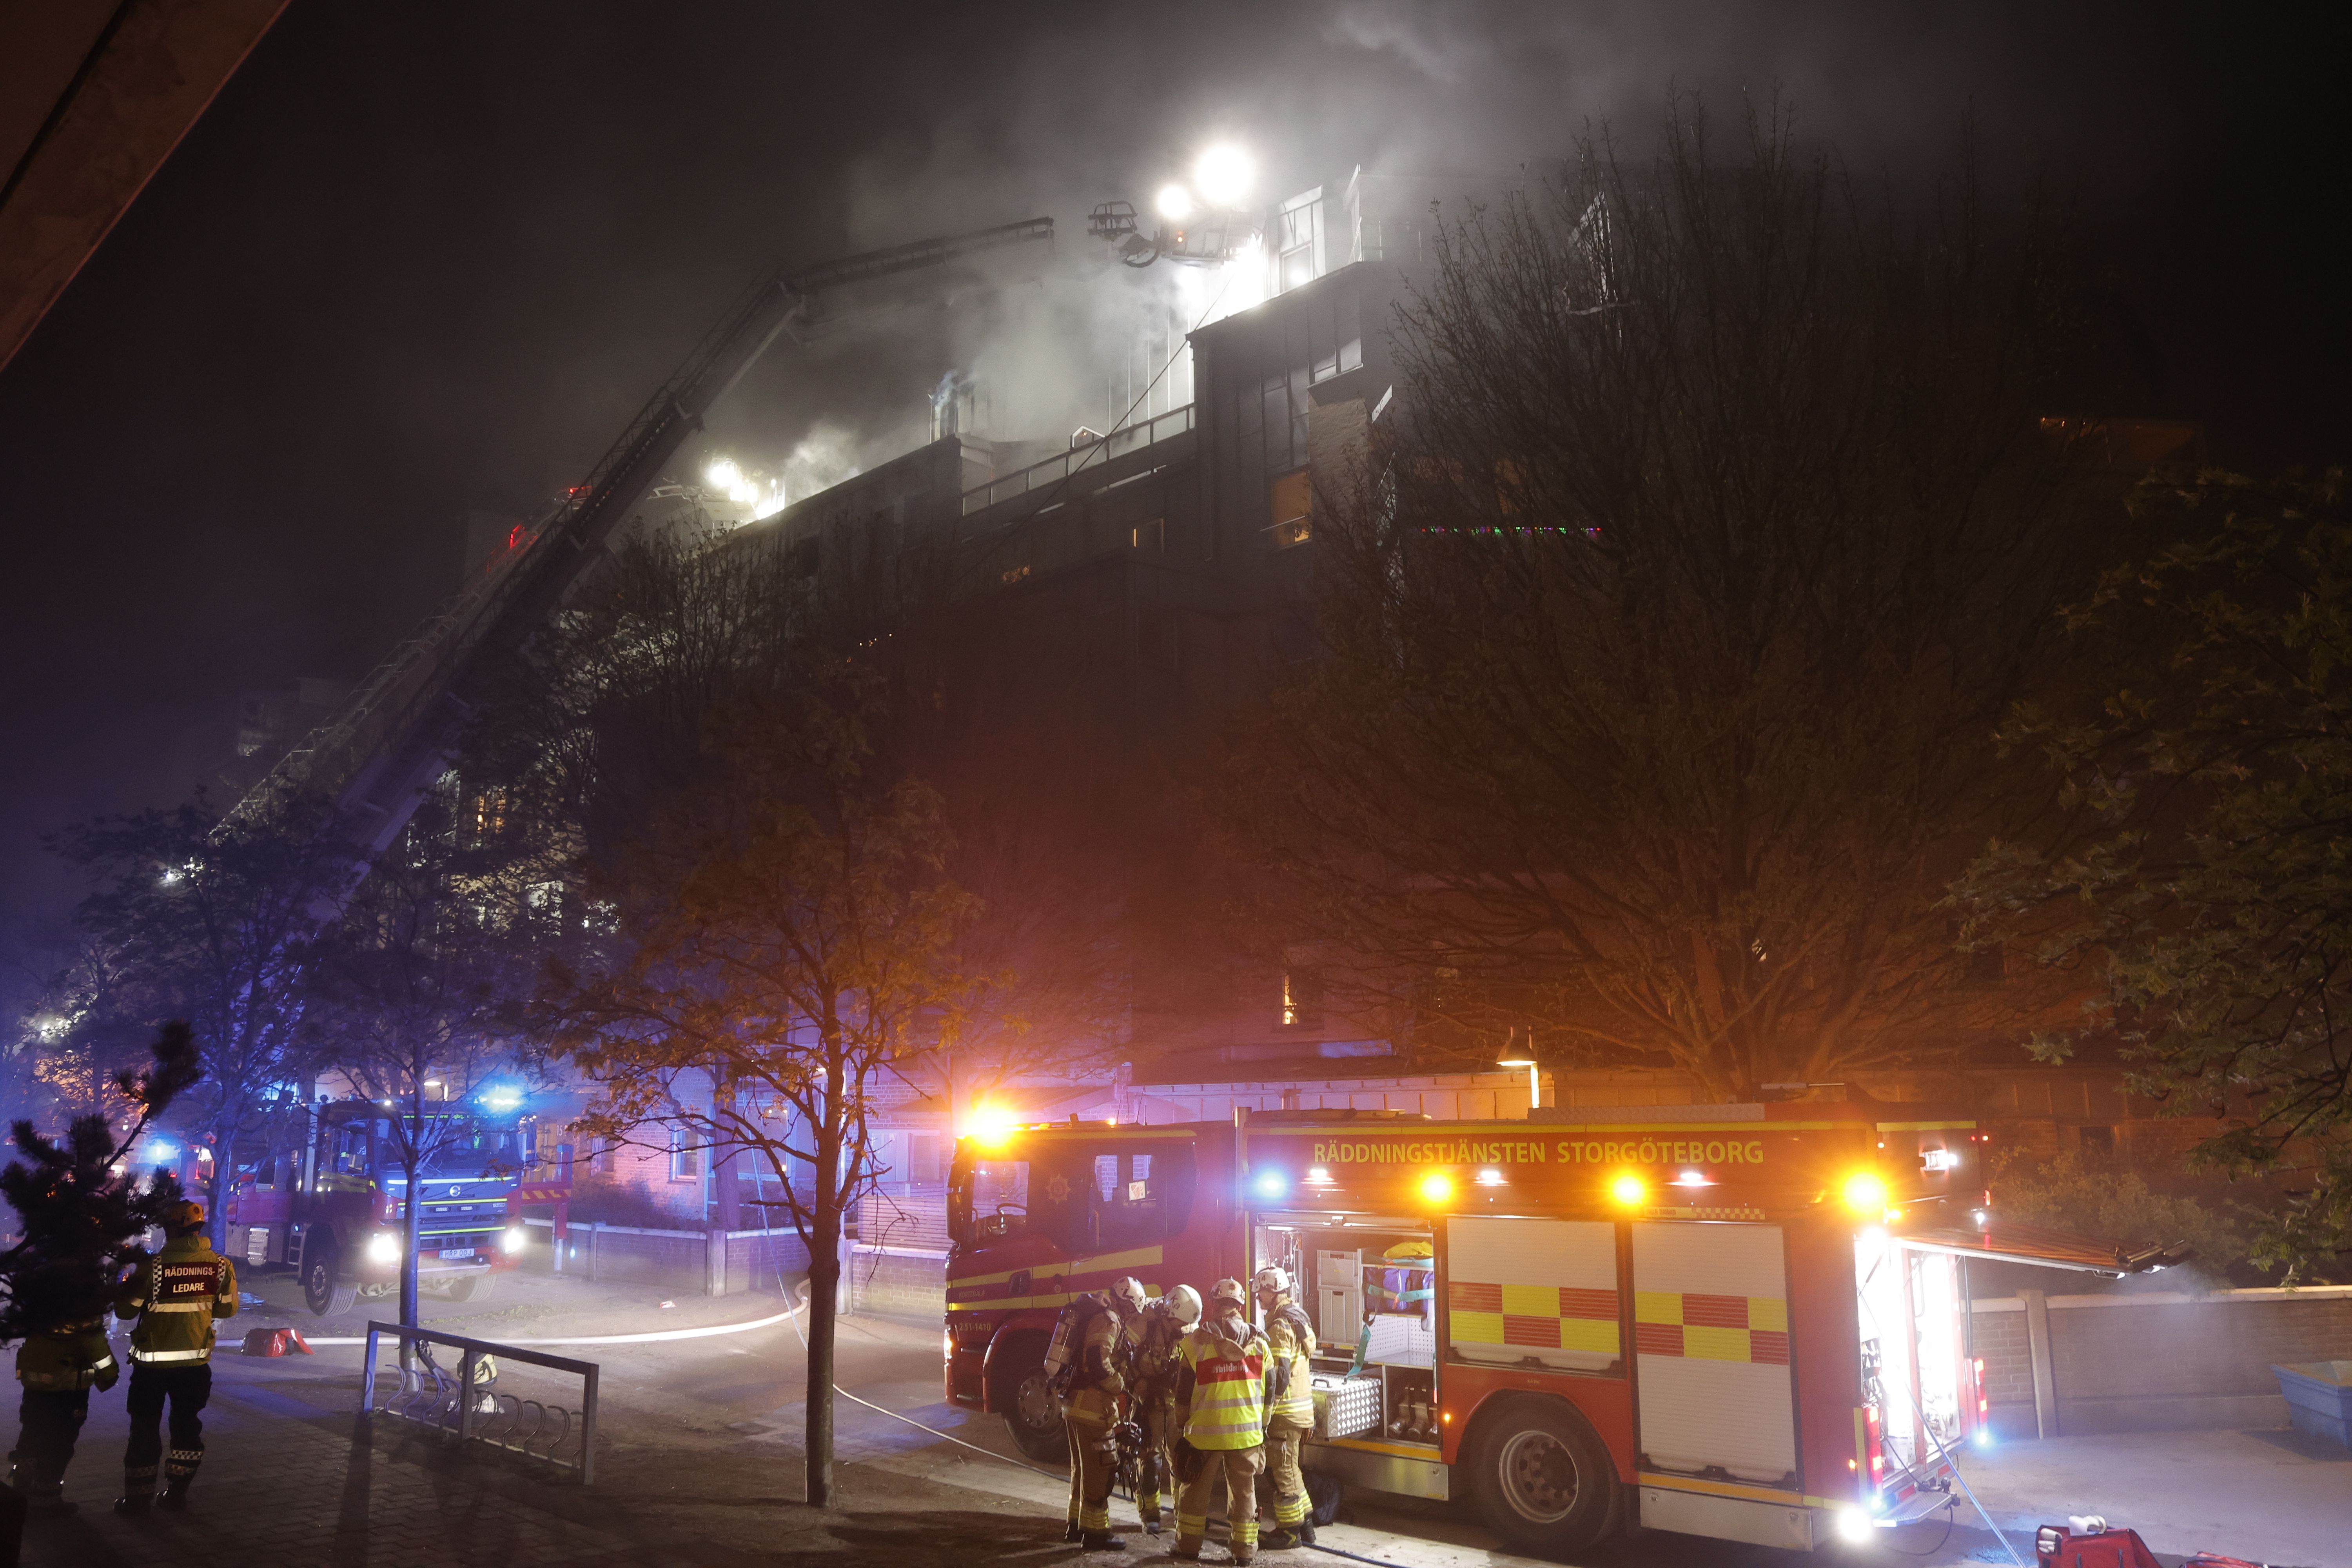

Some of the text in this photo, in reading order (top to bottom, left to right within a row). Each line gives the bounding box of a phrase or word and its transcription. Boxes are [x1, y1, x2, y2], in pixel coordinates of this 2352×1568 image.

[1314, 1137, 1764, 1164] RÄDDNINGSTJÄNSTEN STORGÖTEBORG
[165, 1267, 215, 1278] RÄDDNINGS-
[1258, 1274, 1265, 1283] 14
[173, 1282, 205, 1293] LEDARE
